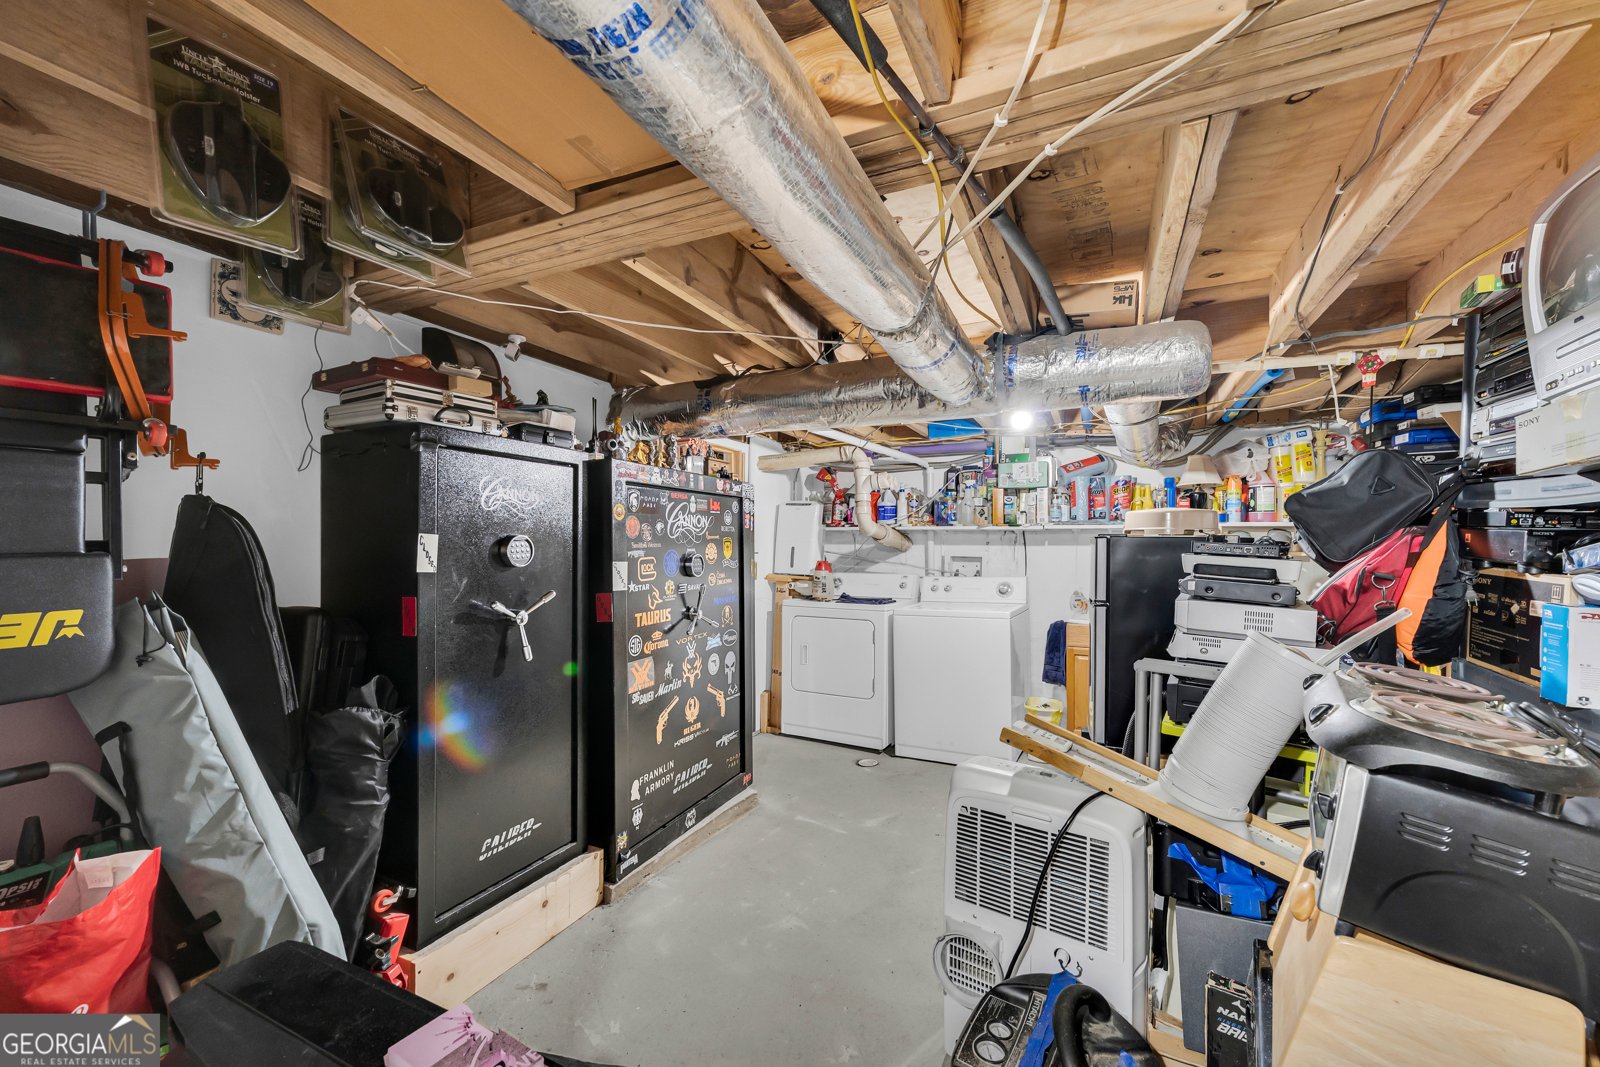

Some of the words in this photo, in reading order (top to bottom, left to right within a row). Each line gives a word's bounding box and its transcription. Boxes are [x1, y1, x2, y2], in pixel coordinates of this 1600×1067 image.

[181, 44, 213, 65] UNCLE
[173, 58, 190, 72] IWB
[233, 87, 262, 103] Holster
[1518, 415, 1541, 429] SONY
[665, 501, 714, 540] CANNON
[634, 583, 650, 592] STAR
[634, 608, 672, 628] TAURUS
[643, 638, 670, 654] Corona
[675, 631, 709, 645] VORTEX
[655, 678, 683, 698] Marlin
[639, 760, 675, 786] FRANKLIN
[645, 771, 676, 796] ARMORY
[1026, 997, 1042, 1027] HITACHI
